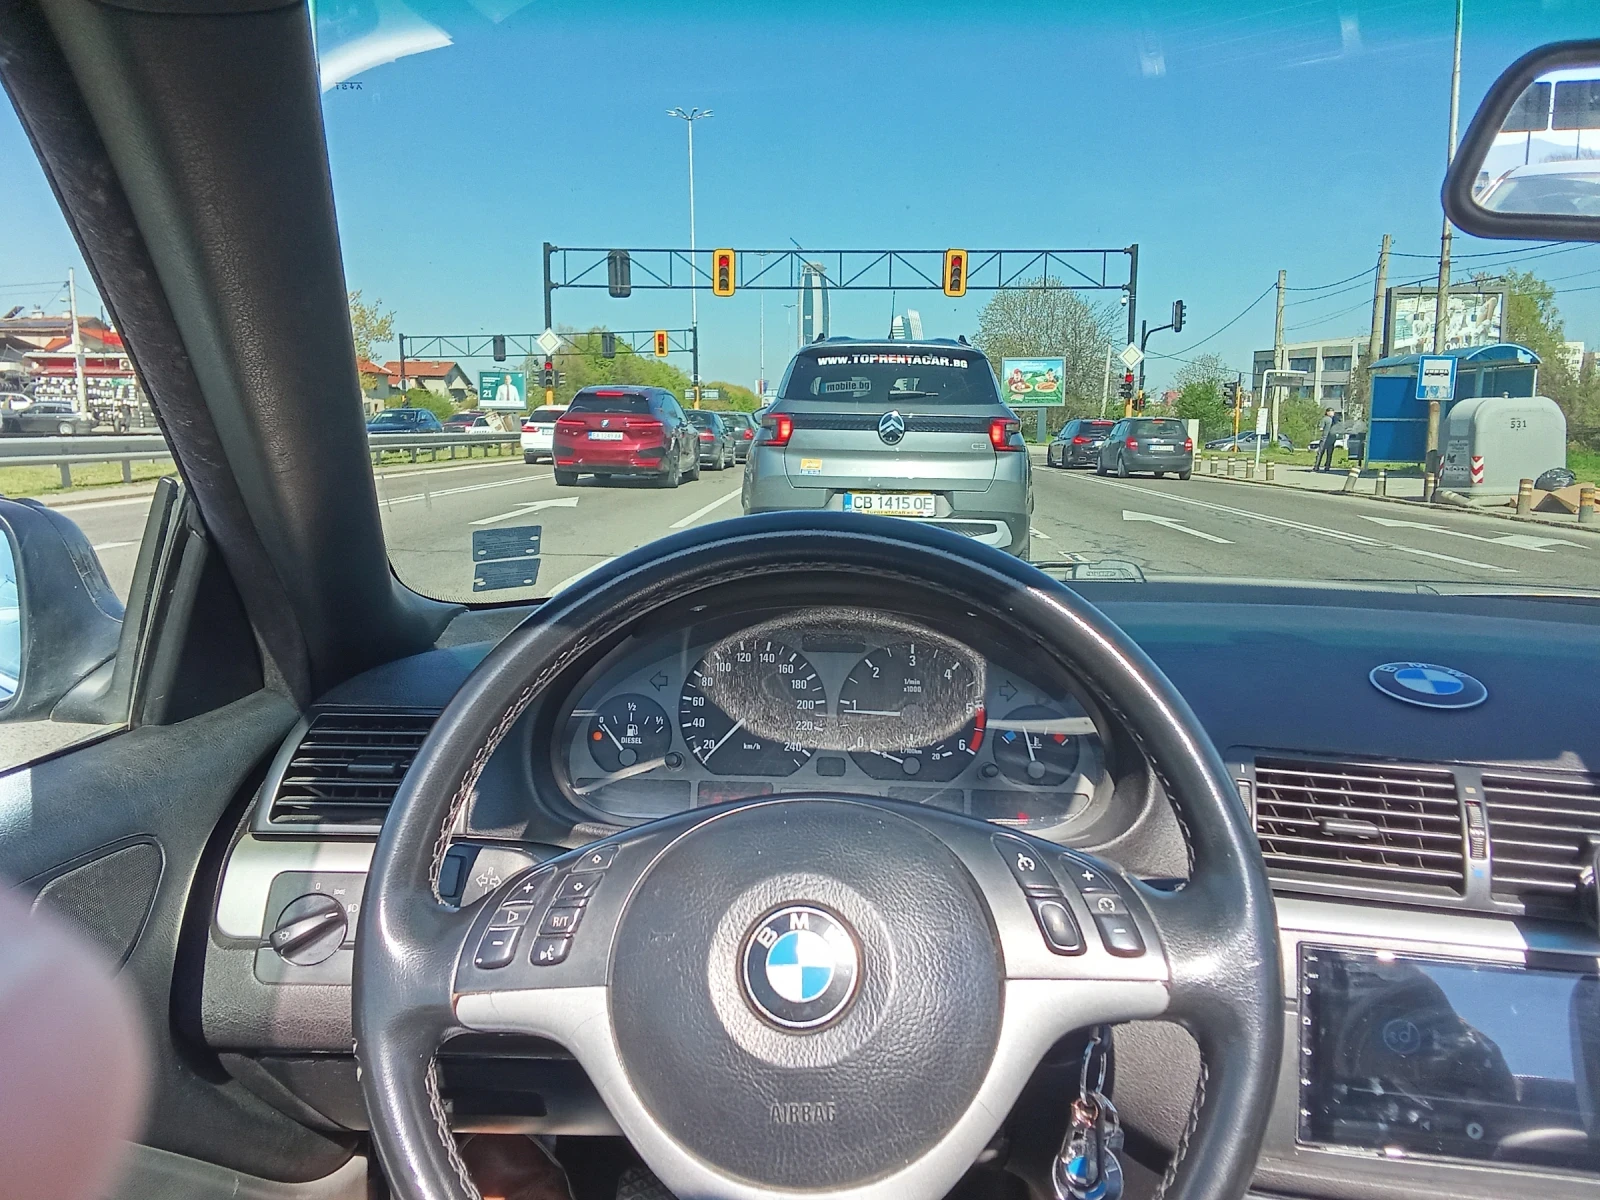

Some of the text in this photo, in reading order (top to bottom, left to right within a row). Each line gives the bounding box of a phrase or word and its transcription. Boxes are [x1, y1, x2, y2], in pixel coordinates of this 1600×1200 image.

[817, 354, 968, 369] WWW.TOPRENTACAR.BG
[826, 380, 870, 391] mobile.bg
[482, 389, 492, 398] 21
[1510, 420, 1527, 429] 531
[854, 496, 873, 509] CB
[877, 496, 911, 510] 1415
[736, 652, 752, 662] 120
[759, 653, 775, 663] 140
[909, 655, 916, 667] 3
[715, 662, 732, 672] 100
[778, 664, 794, 674] 160
[872, 667, 880, 679] 2
[944, 669, 952, 680] 4
[702, 677, 713, 687] 80
[791, 680, 807, 690] 180
[692, 696, 705, 707] 60
[796, 699, 815, 710] 200
[851, 699, 857, 711] 1
[965, 702, 973, 714] 5
[692, 718, 705, 728] 40
[795, 720, 813, 731] 220
[620, 736, 643, 744] DIESEL
[703, 739, 715, 749] 20
[857, 736, 864, 748] 0
[959, 739, 966, 751] 6
[743, 742, 761, 750] km/h
[784, 741, 802, 752] 240
[552, 916, 569, 927] R/T
[770, 1101, 836, 1123] AIRBAG
